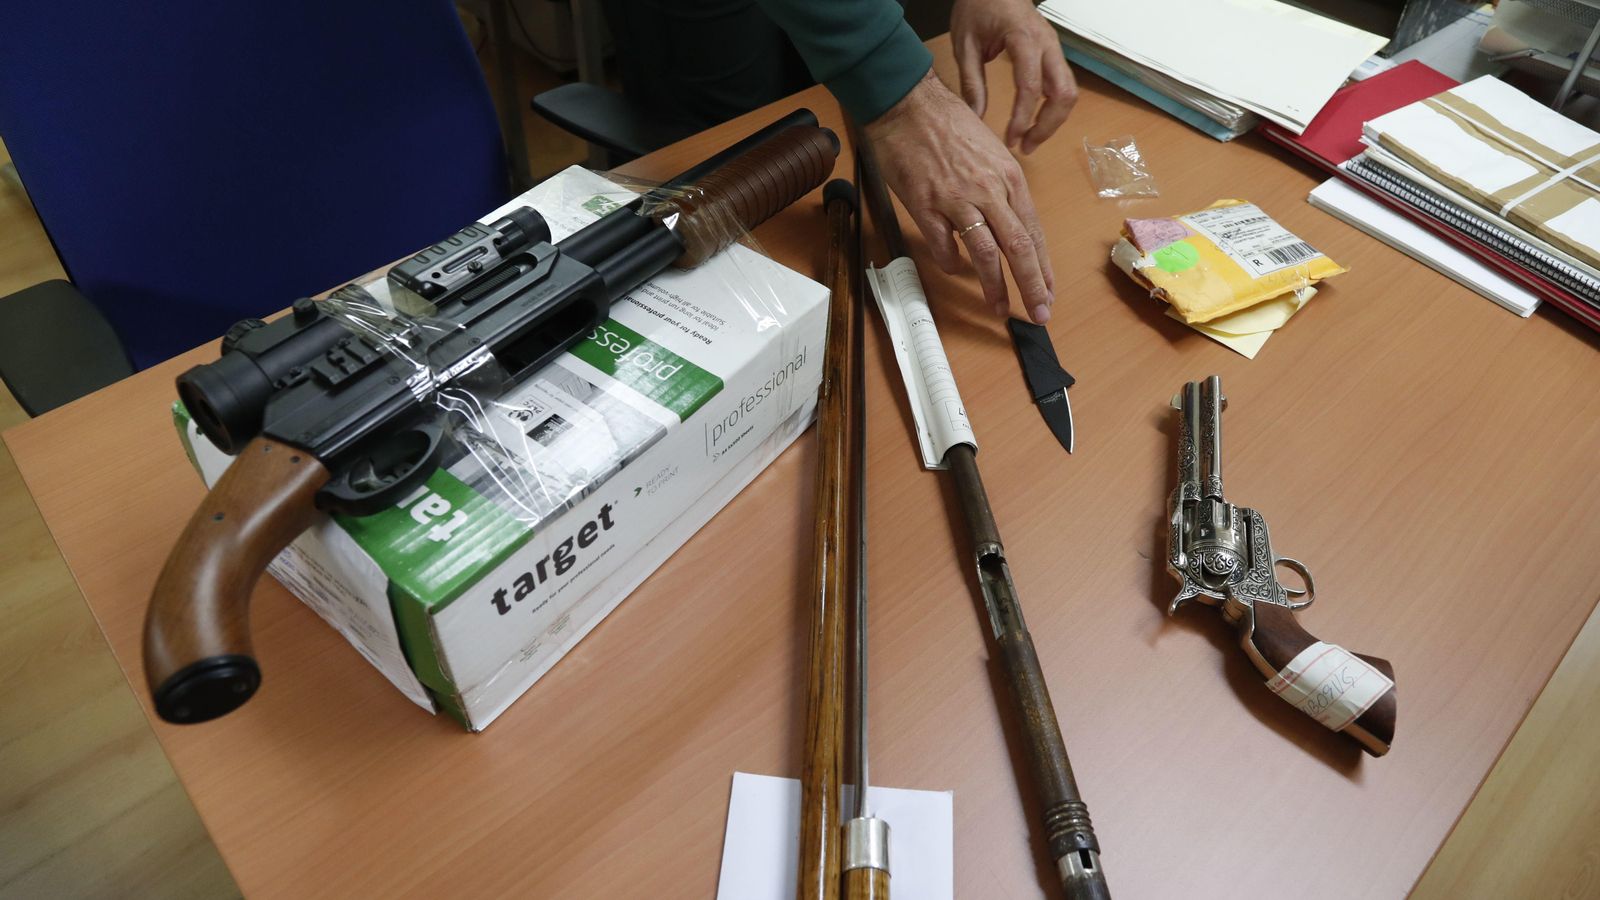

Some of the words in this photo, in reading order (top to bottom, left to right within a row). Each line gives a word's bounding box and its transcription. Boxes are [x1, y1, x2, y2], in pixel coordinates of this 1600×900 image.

[1252, 258, 1263, 267] R
[640, 288, 654, 296] and
[653, 294, 669, 305] print
[624, 295, 664, 319] professional
[667, 302, 679, 310] run
[689, 304, 700, 312] for
[677, 306, 693, 318] long
[699, 309, 725, 325] Suitable
[663, 315, 681, 327] your
[692, 315, 703, 323] for
[678, 324, 690, 334] for
[702, 320, 719, 331] Ideal
[689, 329, 712, 345] Ready
[712, 345, 806, 447] professional
[490, 503, 615, 615] target
